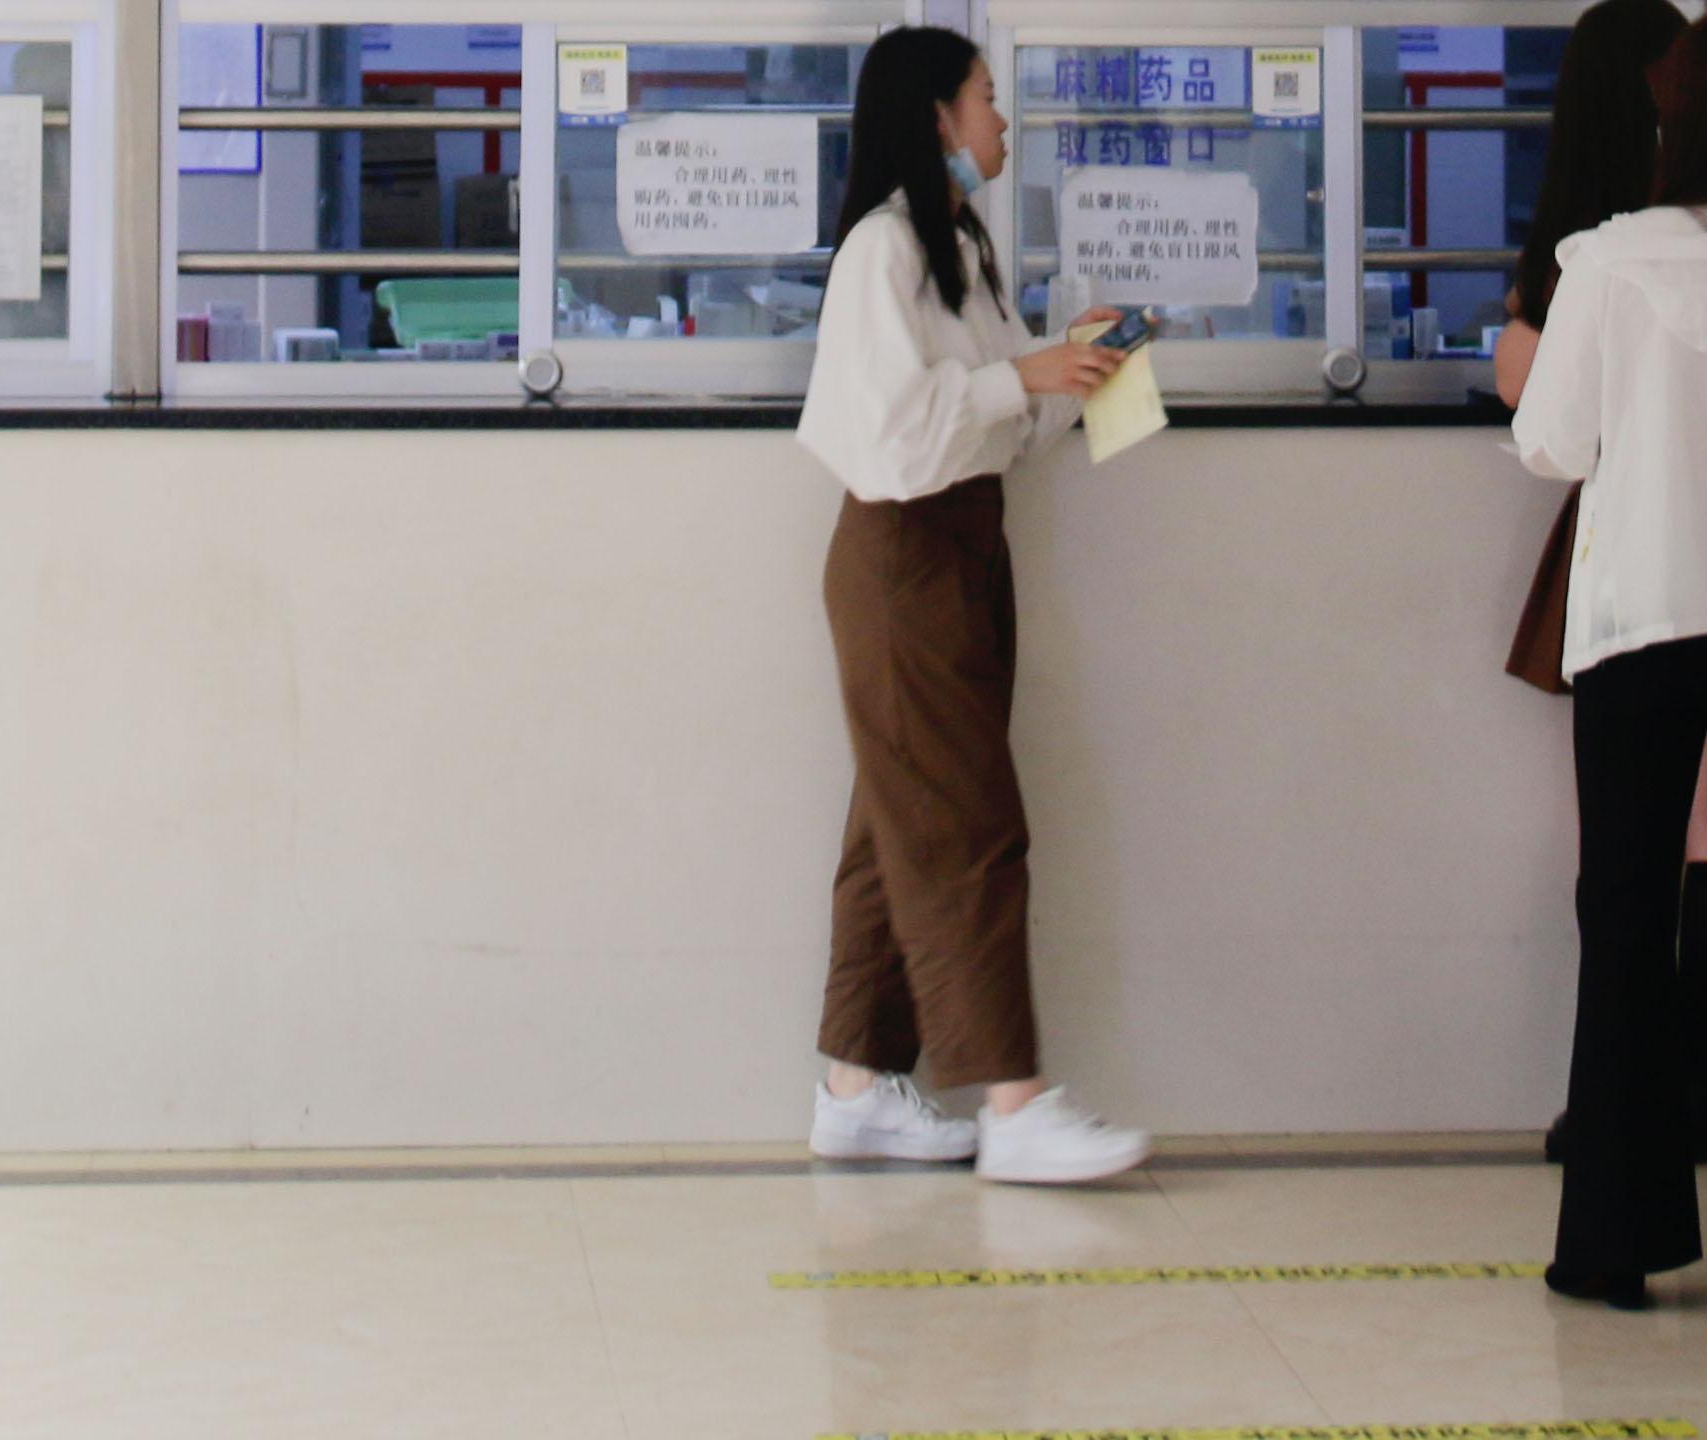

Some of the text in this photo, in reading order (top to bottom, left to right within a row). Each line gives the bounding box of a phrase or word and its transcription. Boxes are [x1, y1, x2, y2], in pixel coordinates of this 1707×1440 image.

[1054, 54, 1216, 103] 麻精药品
[1054, 118, 1215, 167] 取药窗口
